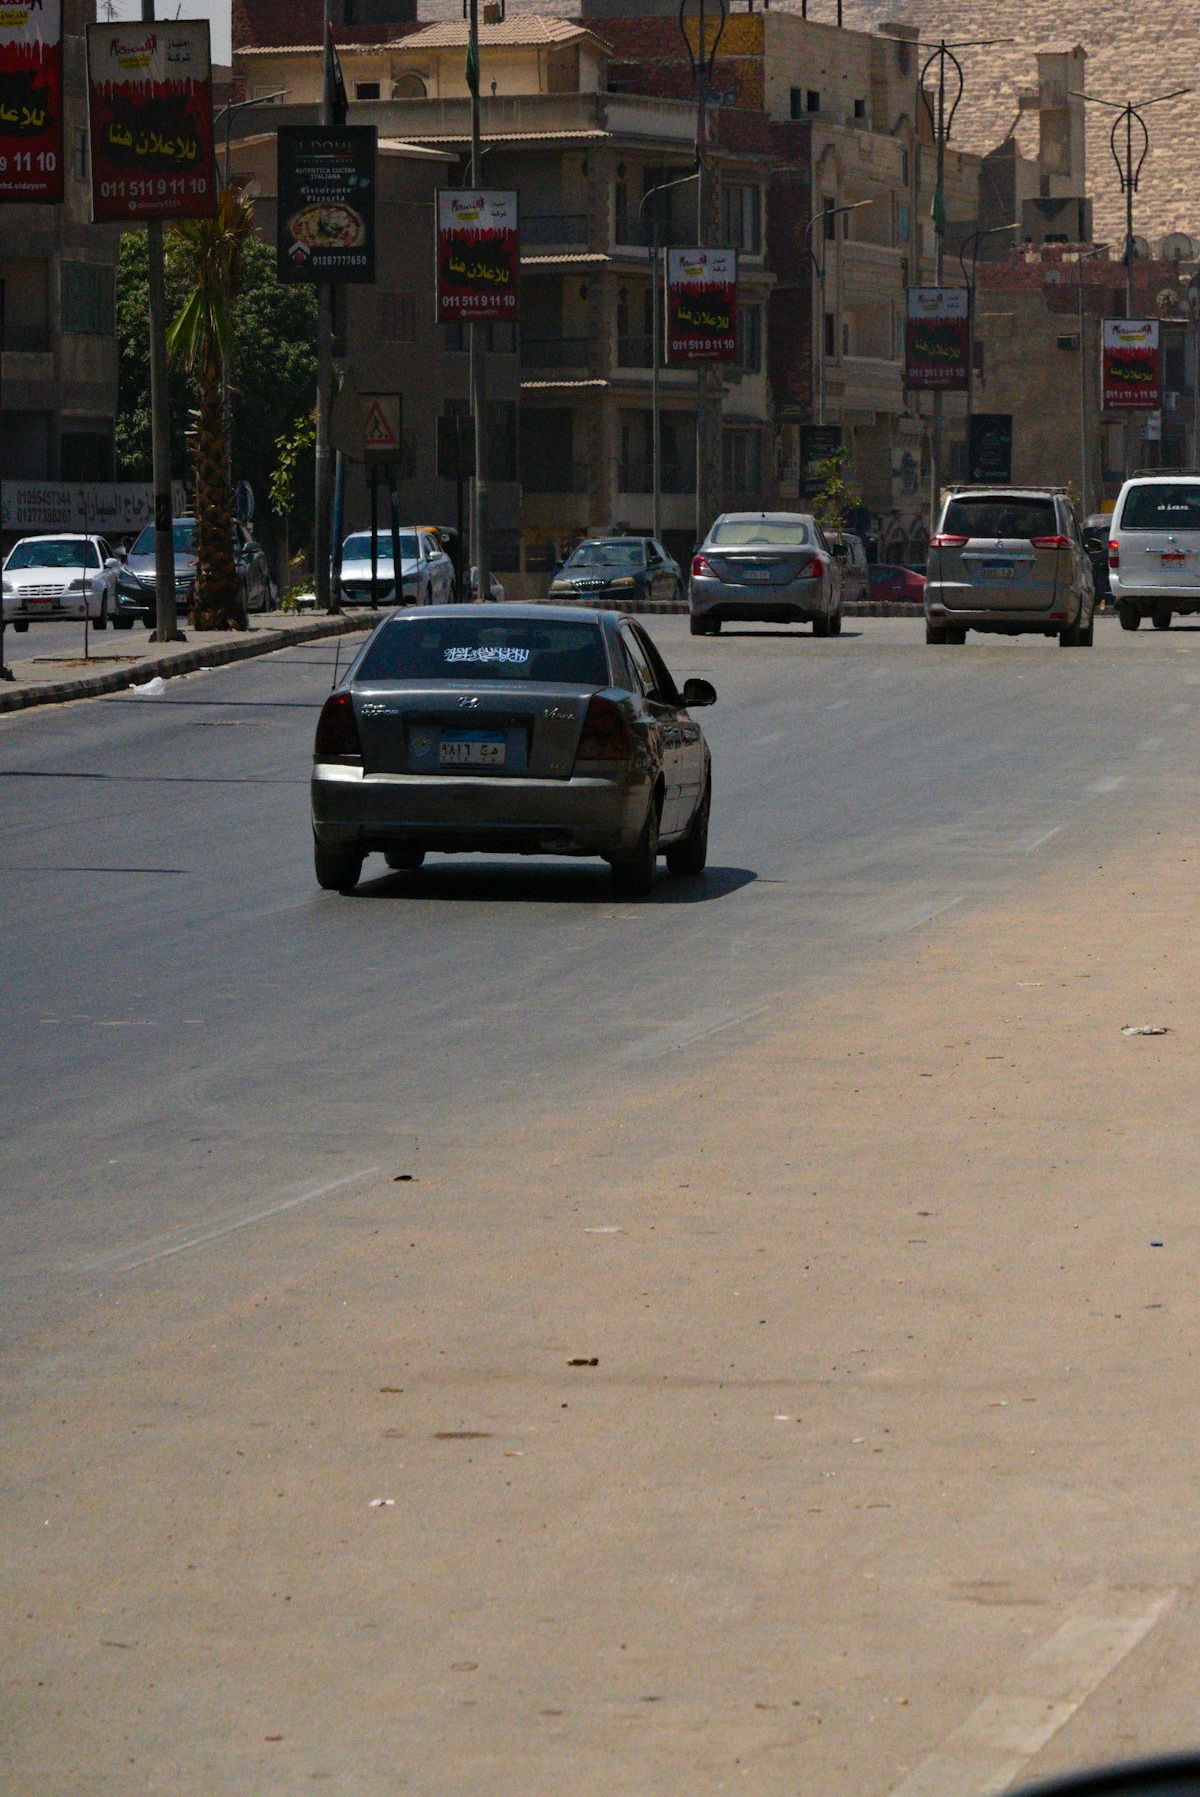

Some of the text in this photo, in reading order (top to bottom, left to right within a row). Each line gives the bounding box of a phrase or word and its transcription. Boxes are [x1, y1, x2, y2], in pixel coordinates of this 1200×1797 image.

[108, 122, 133, 147] هنا
[13, 152, 31, 172] 11
[37, 152, 57, 172] 10
[101, 181, 126, 198] 011
[170, 178, 185, 195] 11
[190, 178, 207, 194] 10
[300, 186, 352, 194] Ristorante
[442, 296, 460, 307] 011
[490, 294, 501, 307] 11
[504, 295, 516, 307] 10
[672, 341, 687, 351] 011
